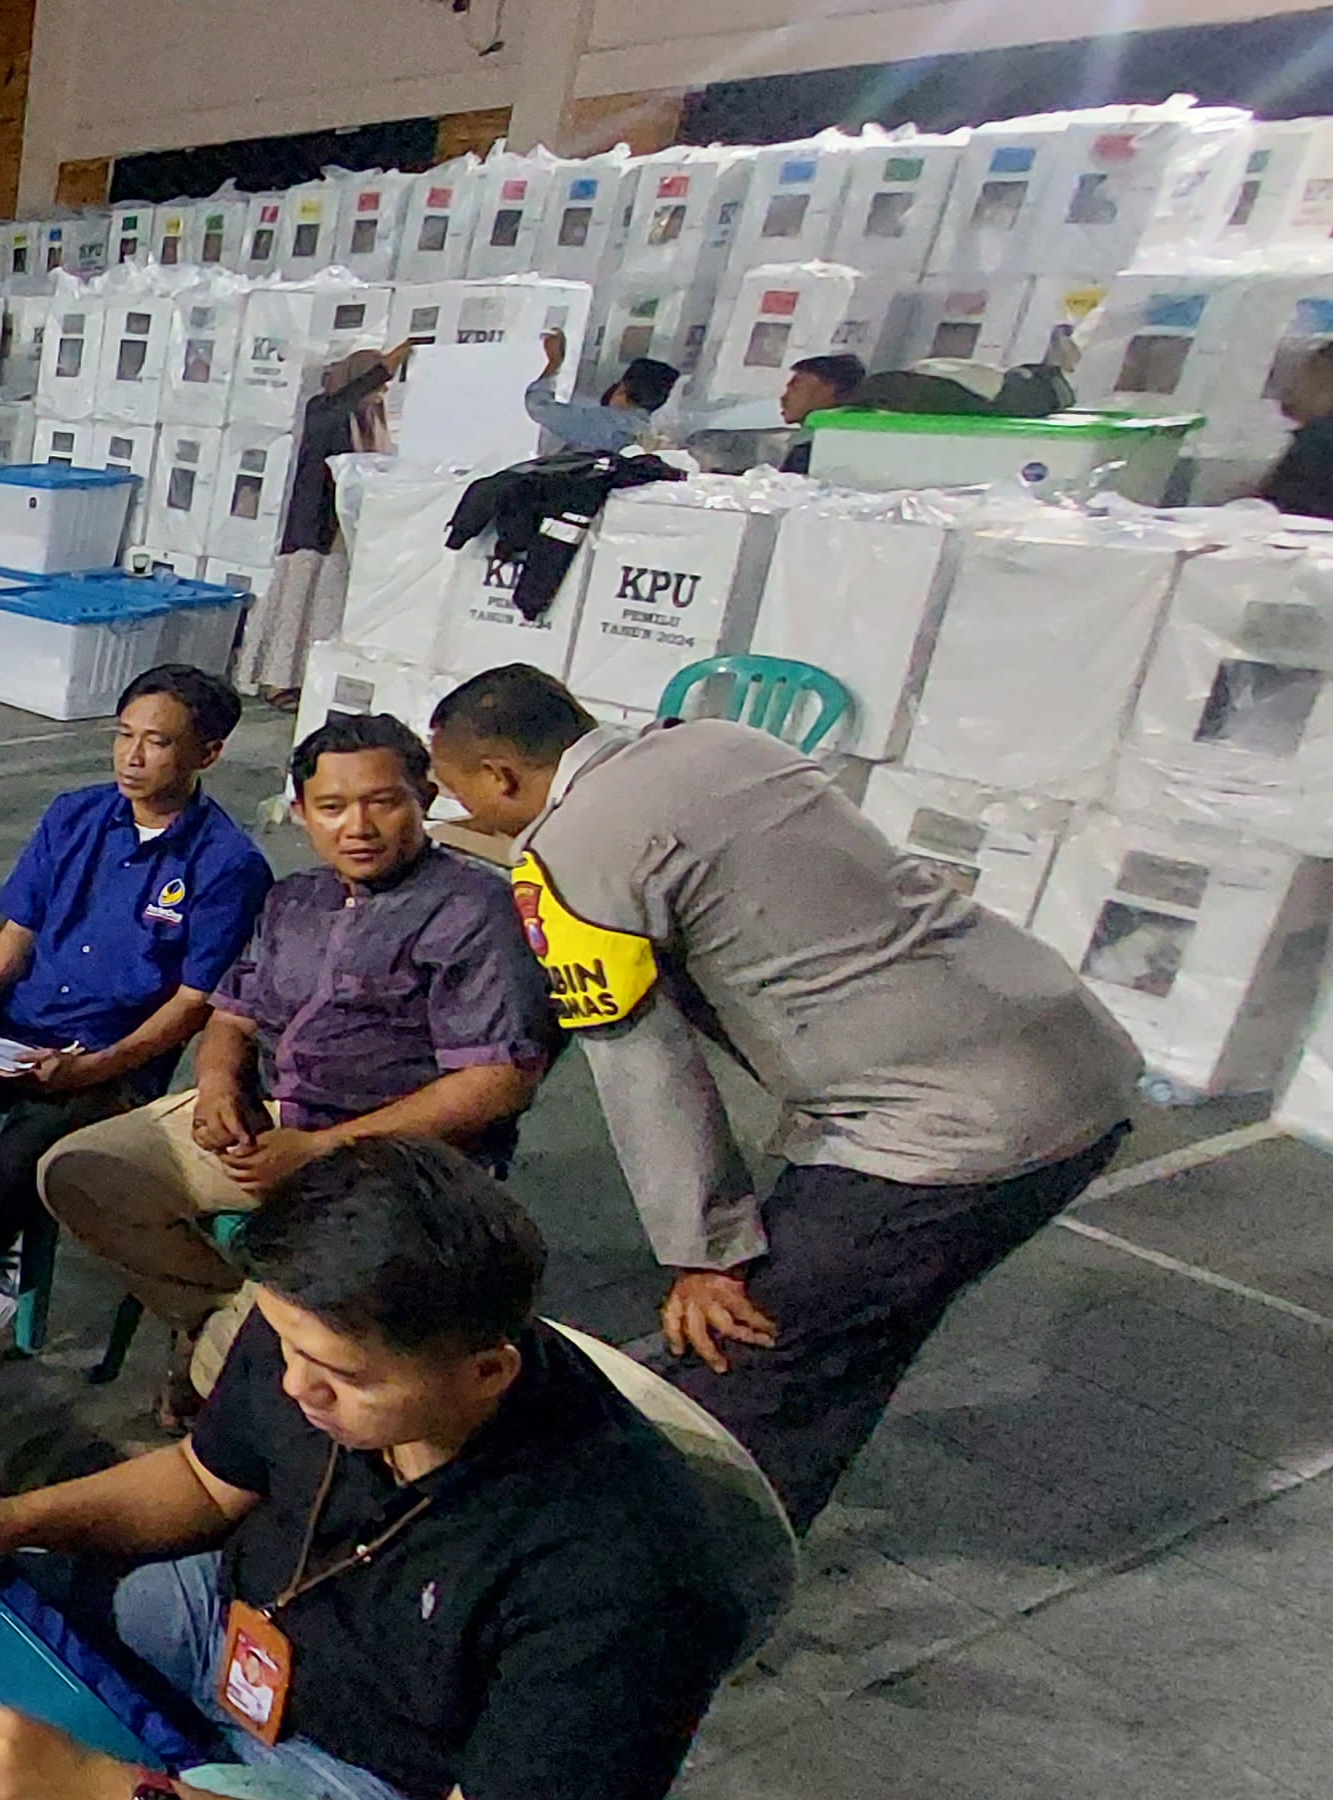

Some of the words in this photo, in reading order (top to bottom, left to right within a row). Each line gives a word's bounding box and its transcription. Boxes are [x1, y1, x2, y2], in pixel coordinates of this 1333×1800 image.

[615, 565, 702, 609] KPU
[600, 622, 653, 640] TAHUN
[656, 631, 696, 648] 2024
[549, 958, 609, 995] BIN
[560, 992, 620, 1019] MAS
